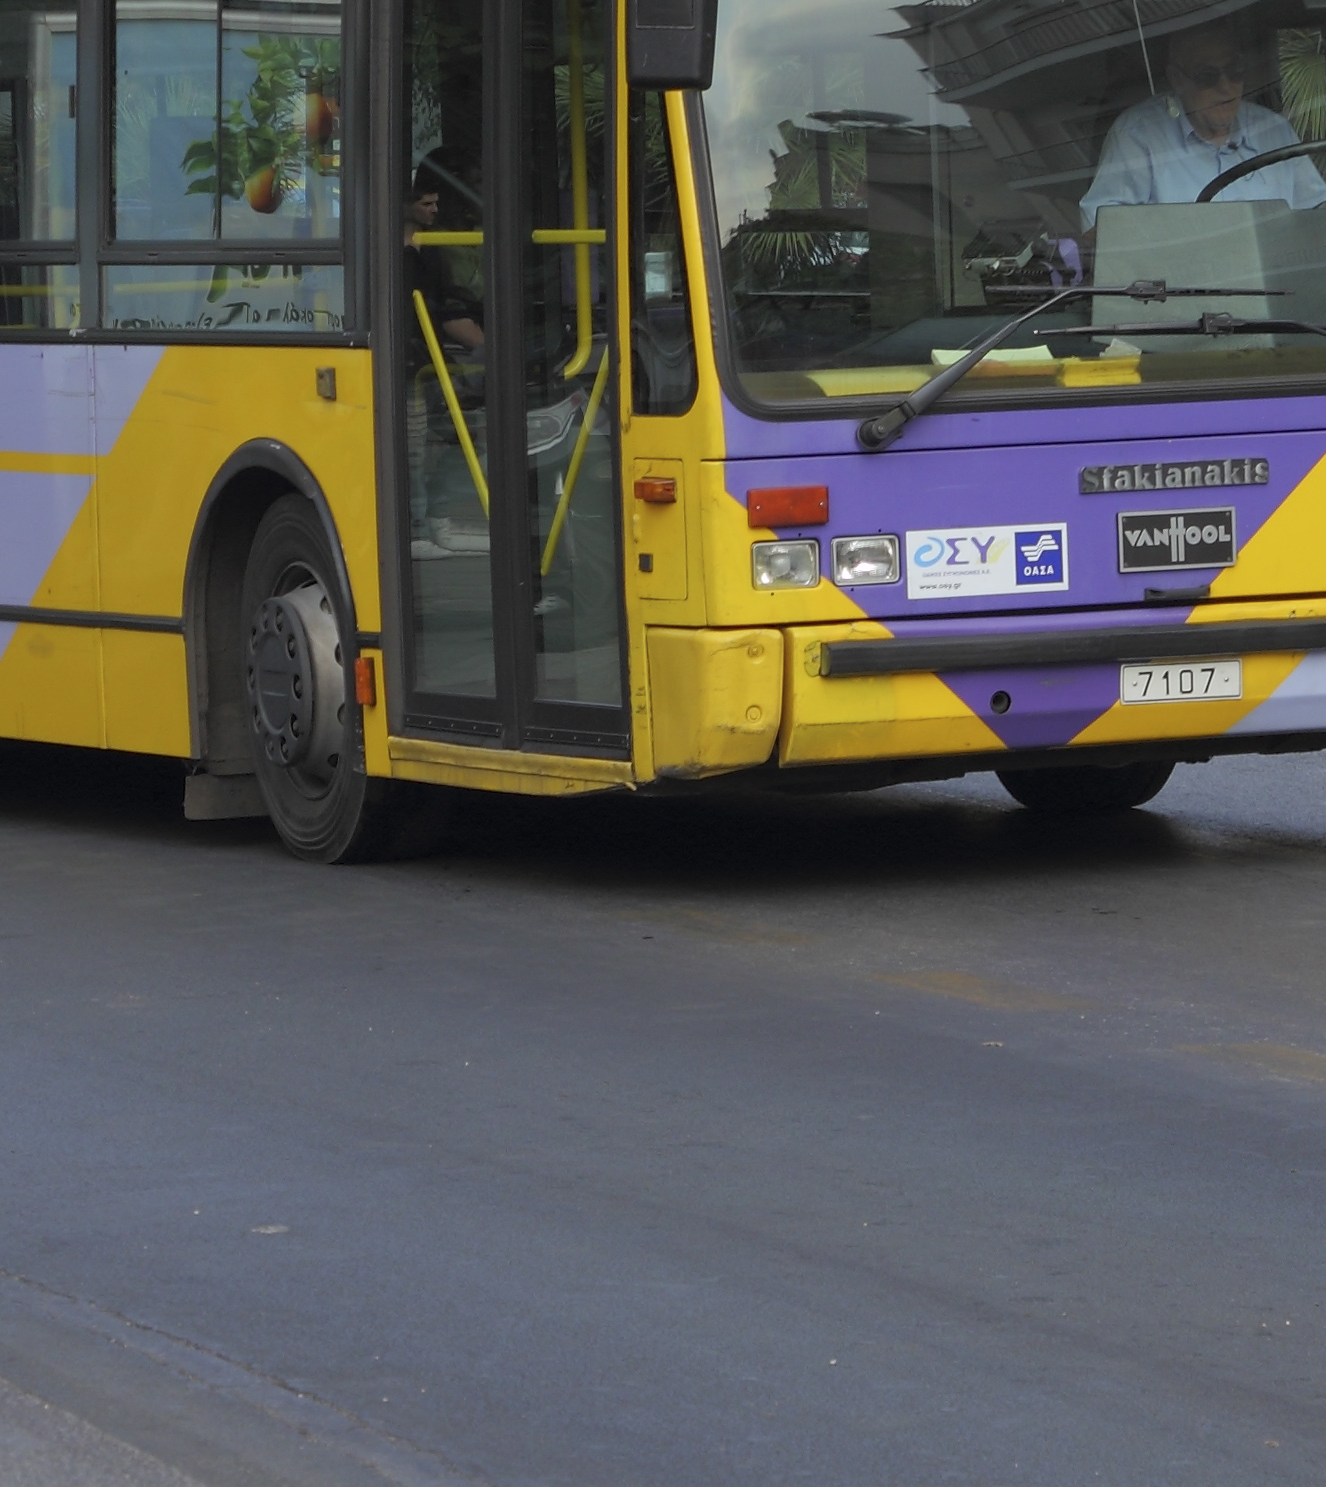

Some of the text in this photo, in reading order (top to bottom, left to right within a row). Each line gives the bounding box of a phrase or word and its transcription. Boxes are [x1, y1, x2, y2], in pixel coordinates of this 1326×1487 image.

[1082, 458, 1270, 493] Sfakianakis
[1023, 565, 1055, 577] ΟΑΣΑ
[1138, 668, 1216, 697] 7107
